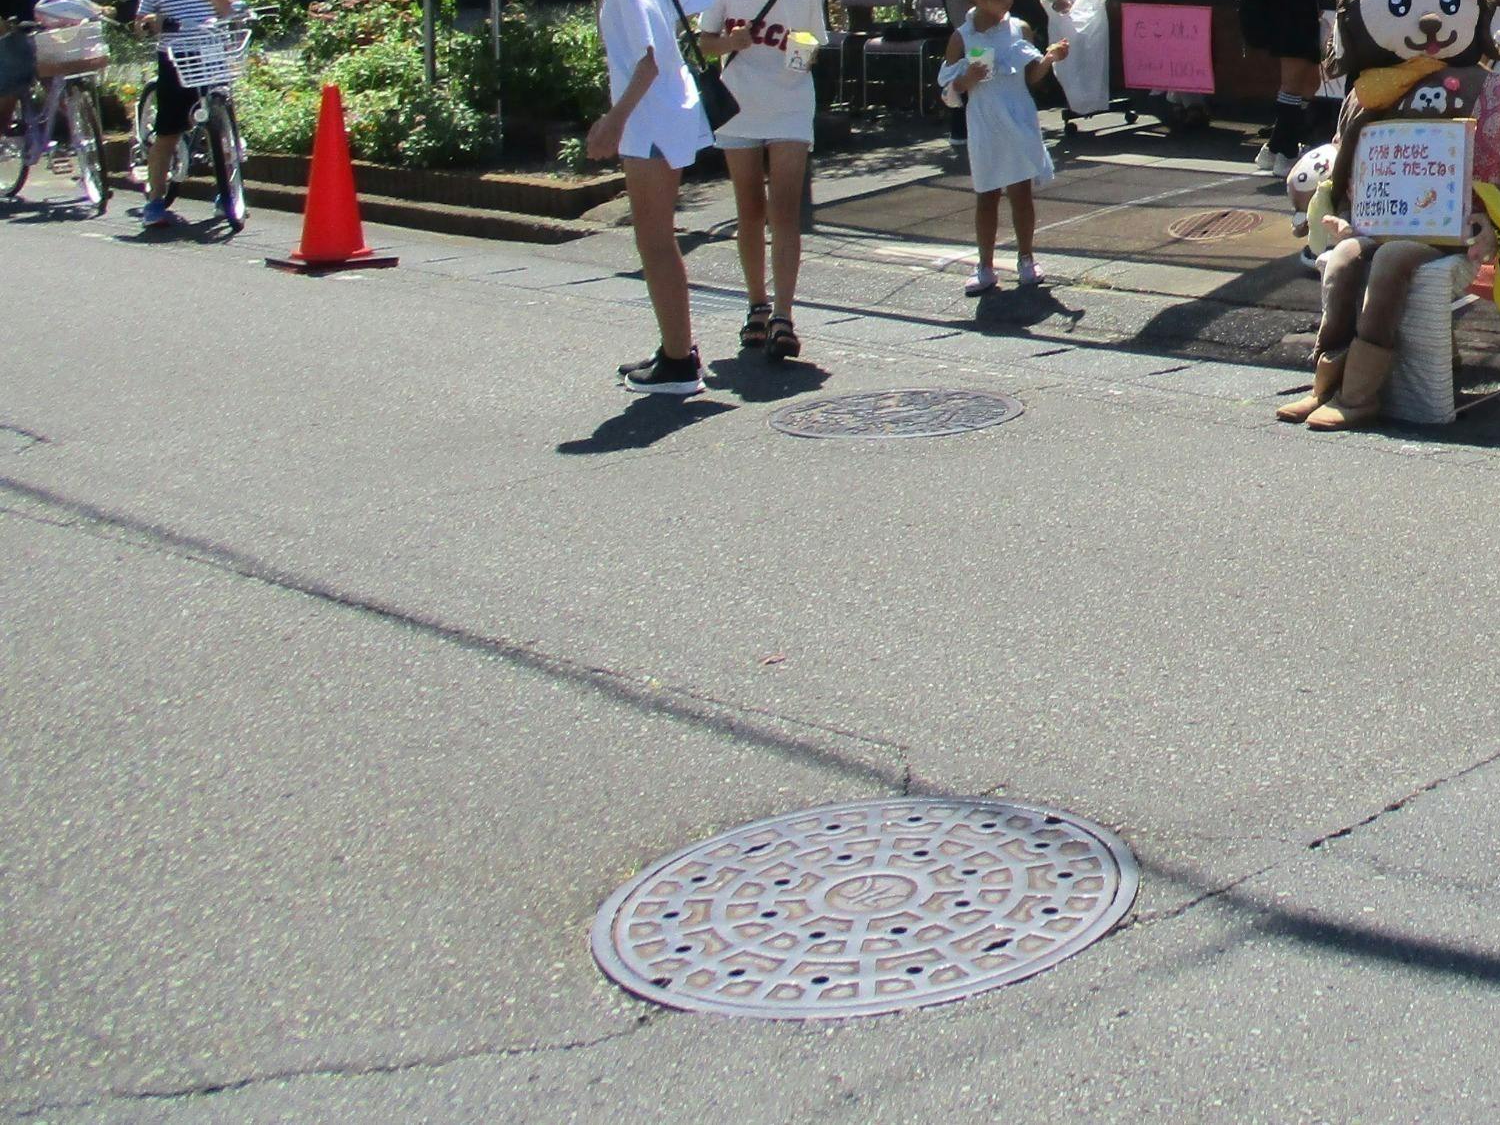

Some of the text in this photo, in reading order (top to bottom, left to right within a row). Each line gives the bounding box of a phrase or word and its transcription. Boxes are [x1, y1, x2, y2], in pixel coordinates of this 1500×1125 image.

[1394, 144, 1429, 160] おとなと
[1402, 161, 1446, 177] わたってね
